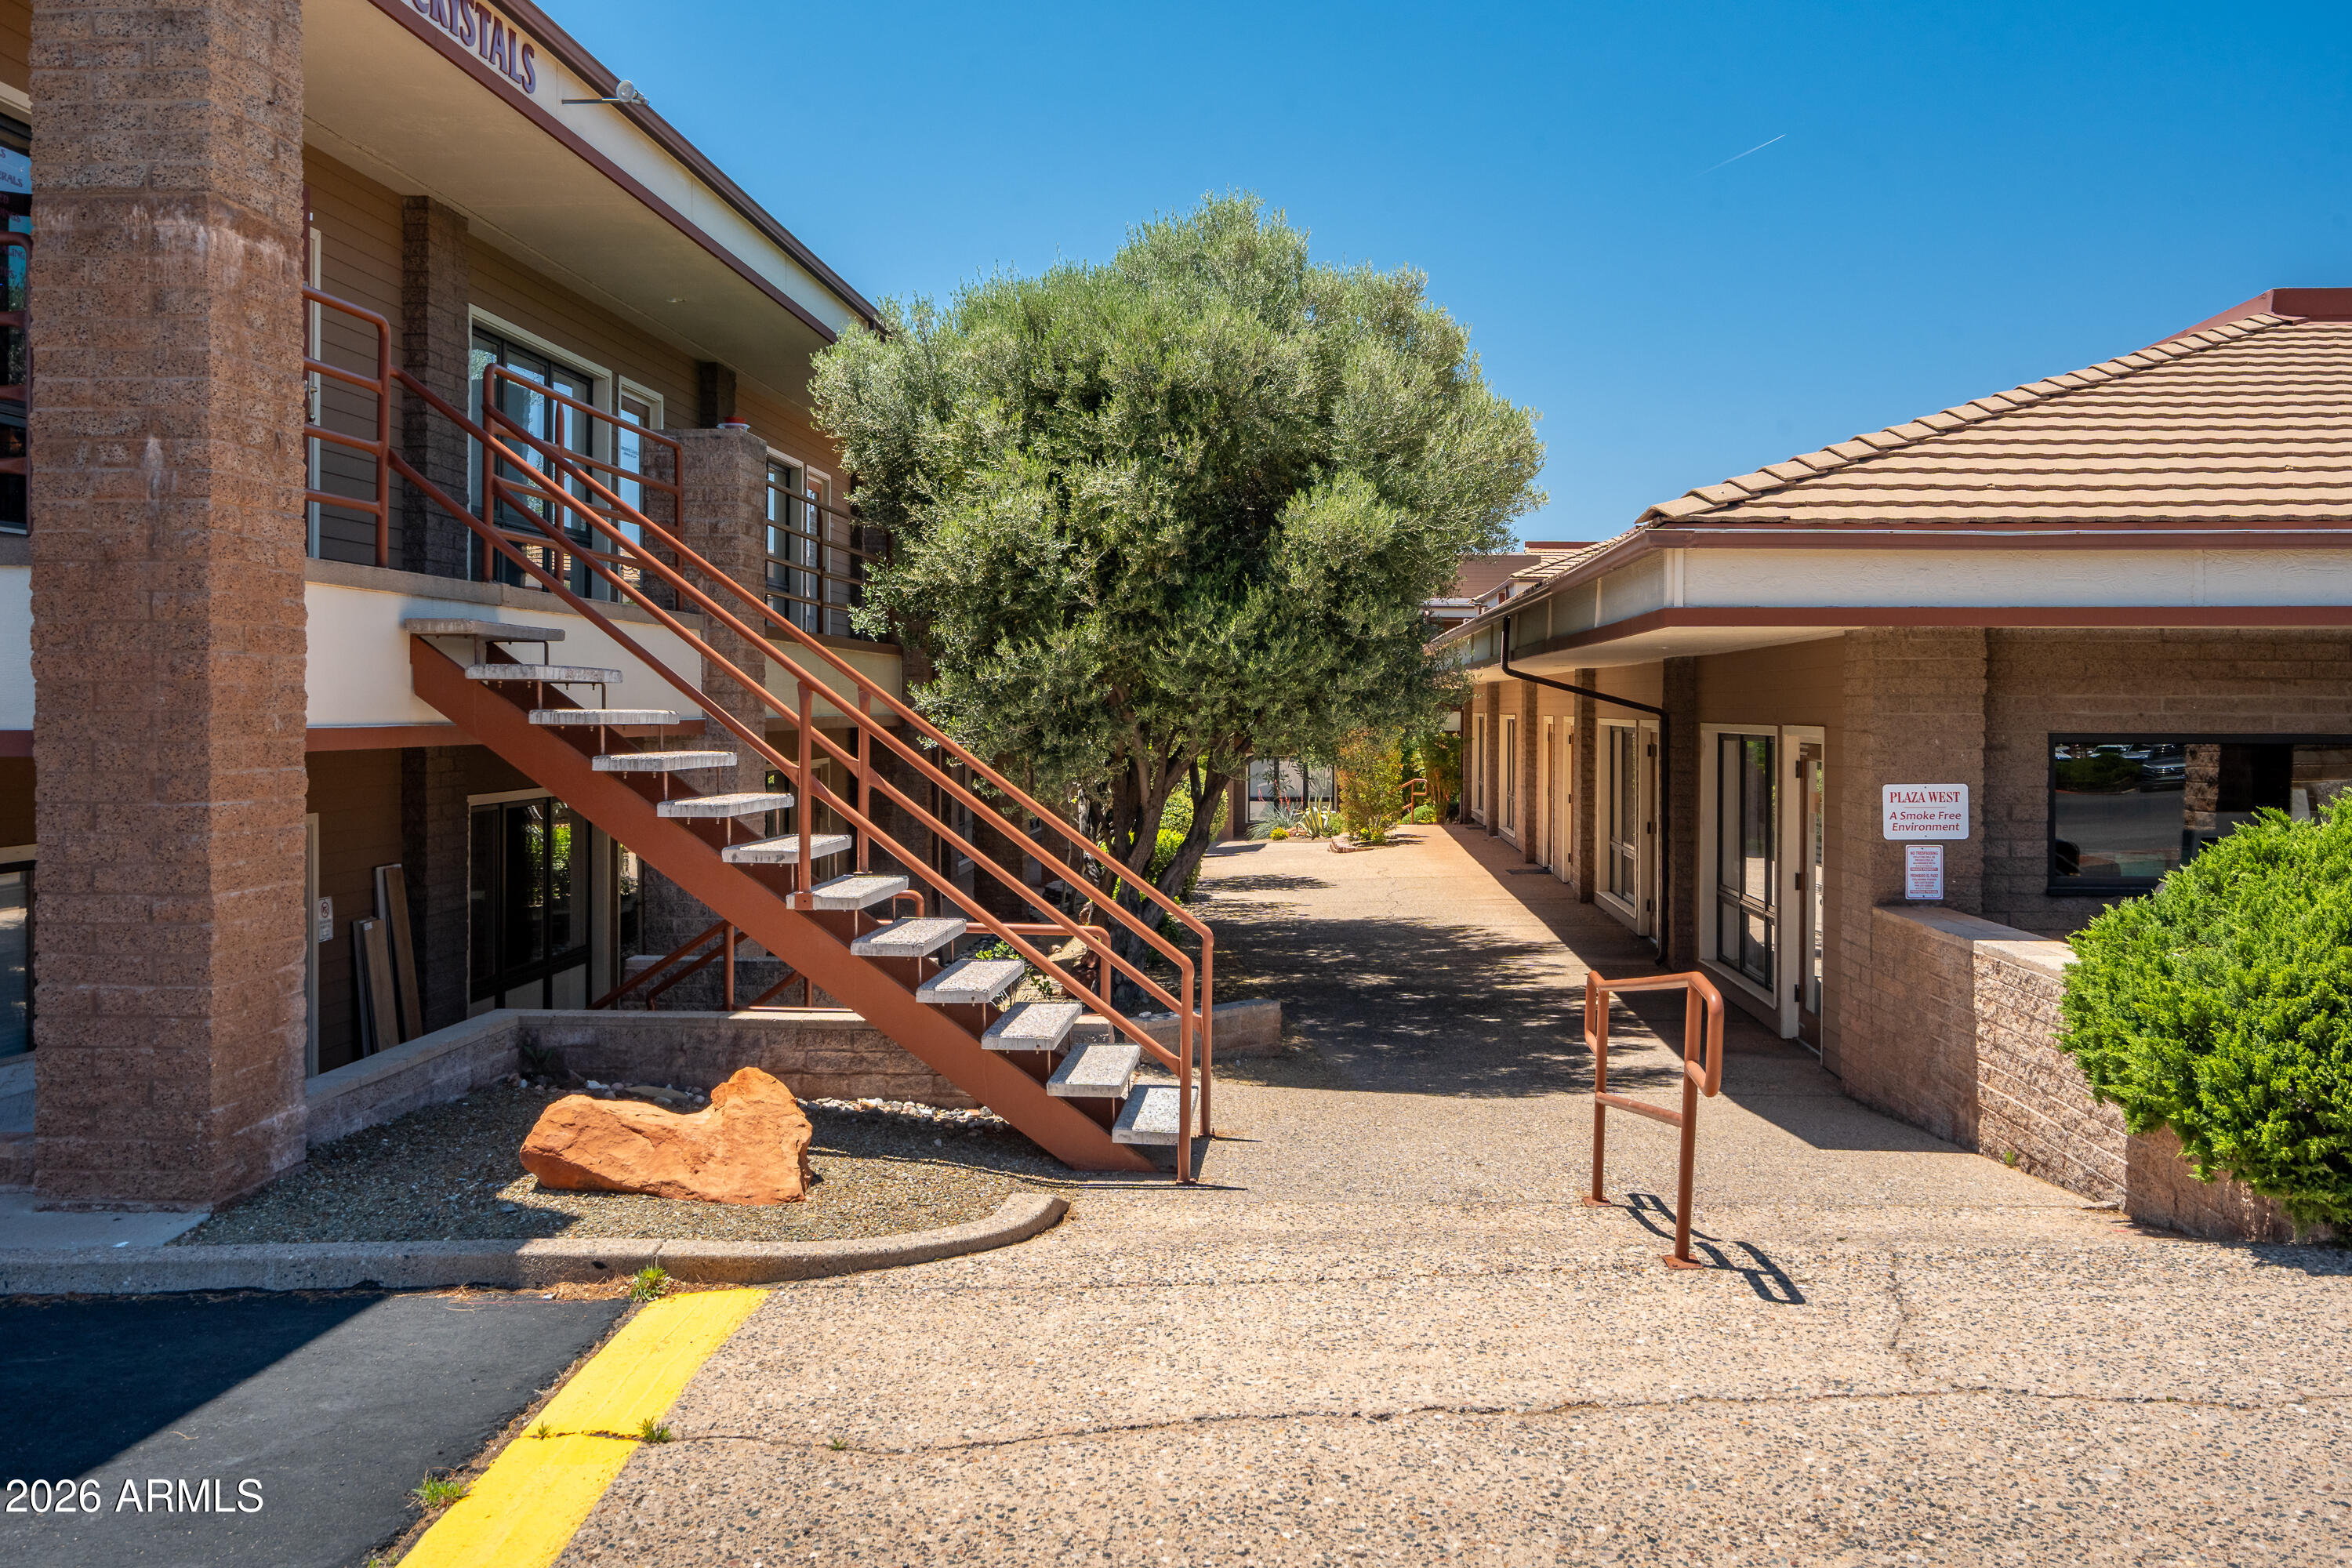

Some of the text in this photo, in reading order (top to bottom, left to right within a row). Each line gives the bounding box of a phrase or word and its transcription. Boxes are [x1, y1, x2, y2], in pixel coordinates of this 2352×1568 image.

[412, 0, 536, 94] YSTALS
[1889, 791, 1961, 804] PLAZA WEST
[1889, 811, 1962, 820] A Smoke Free
[1892, 822, 1960, 831] Environment
